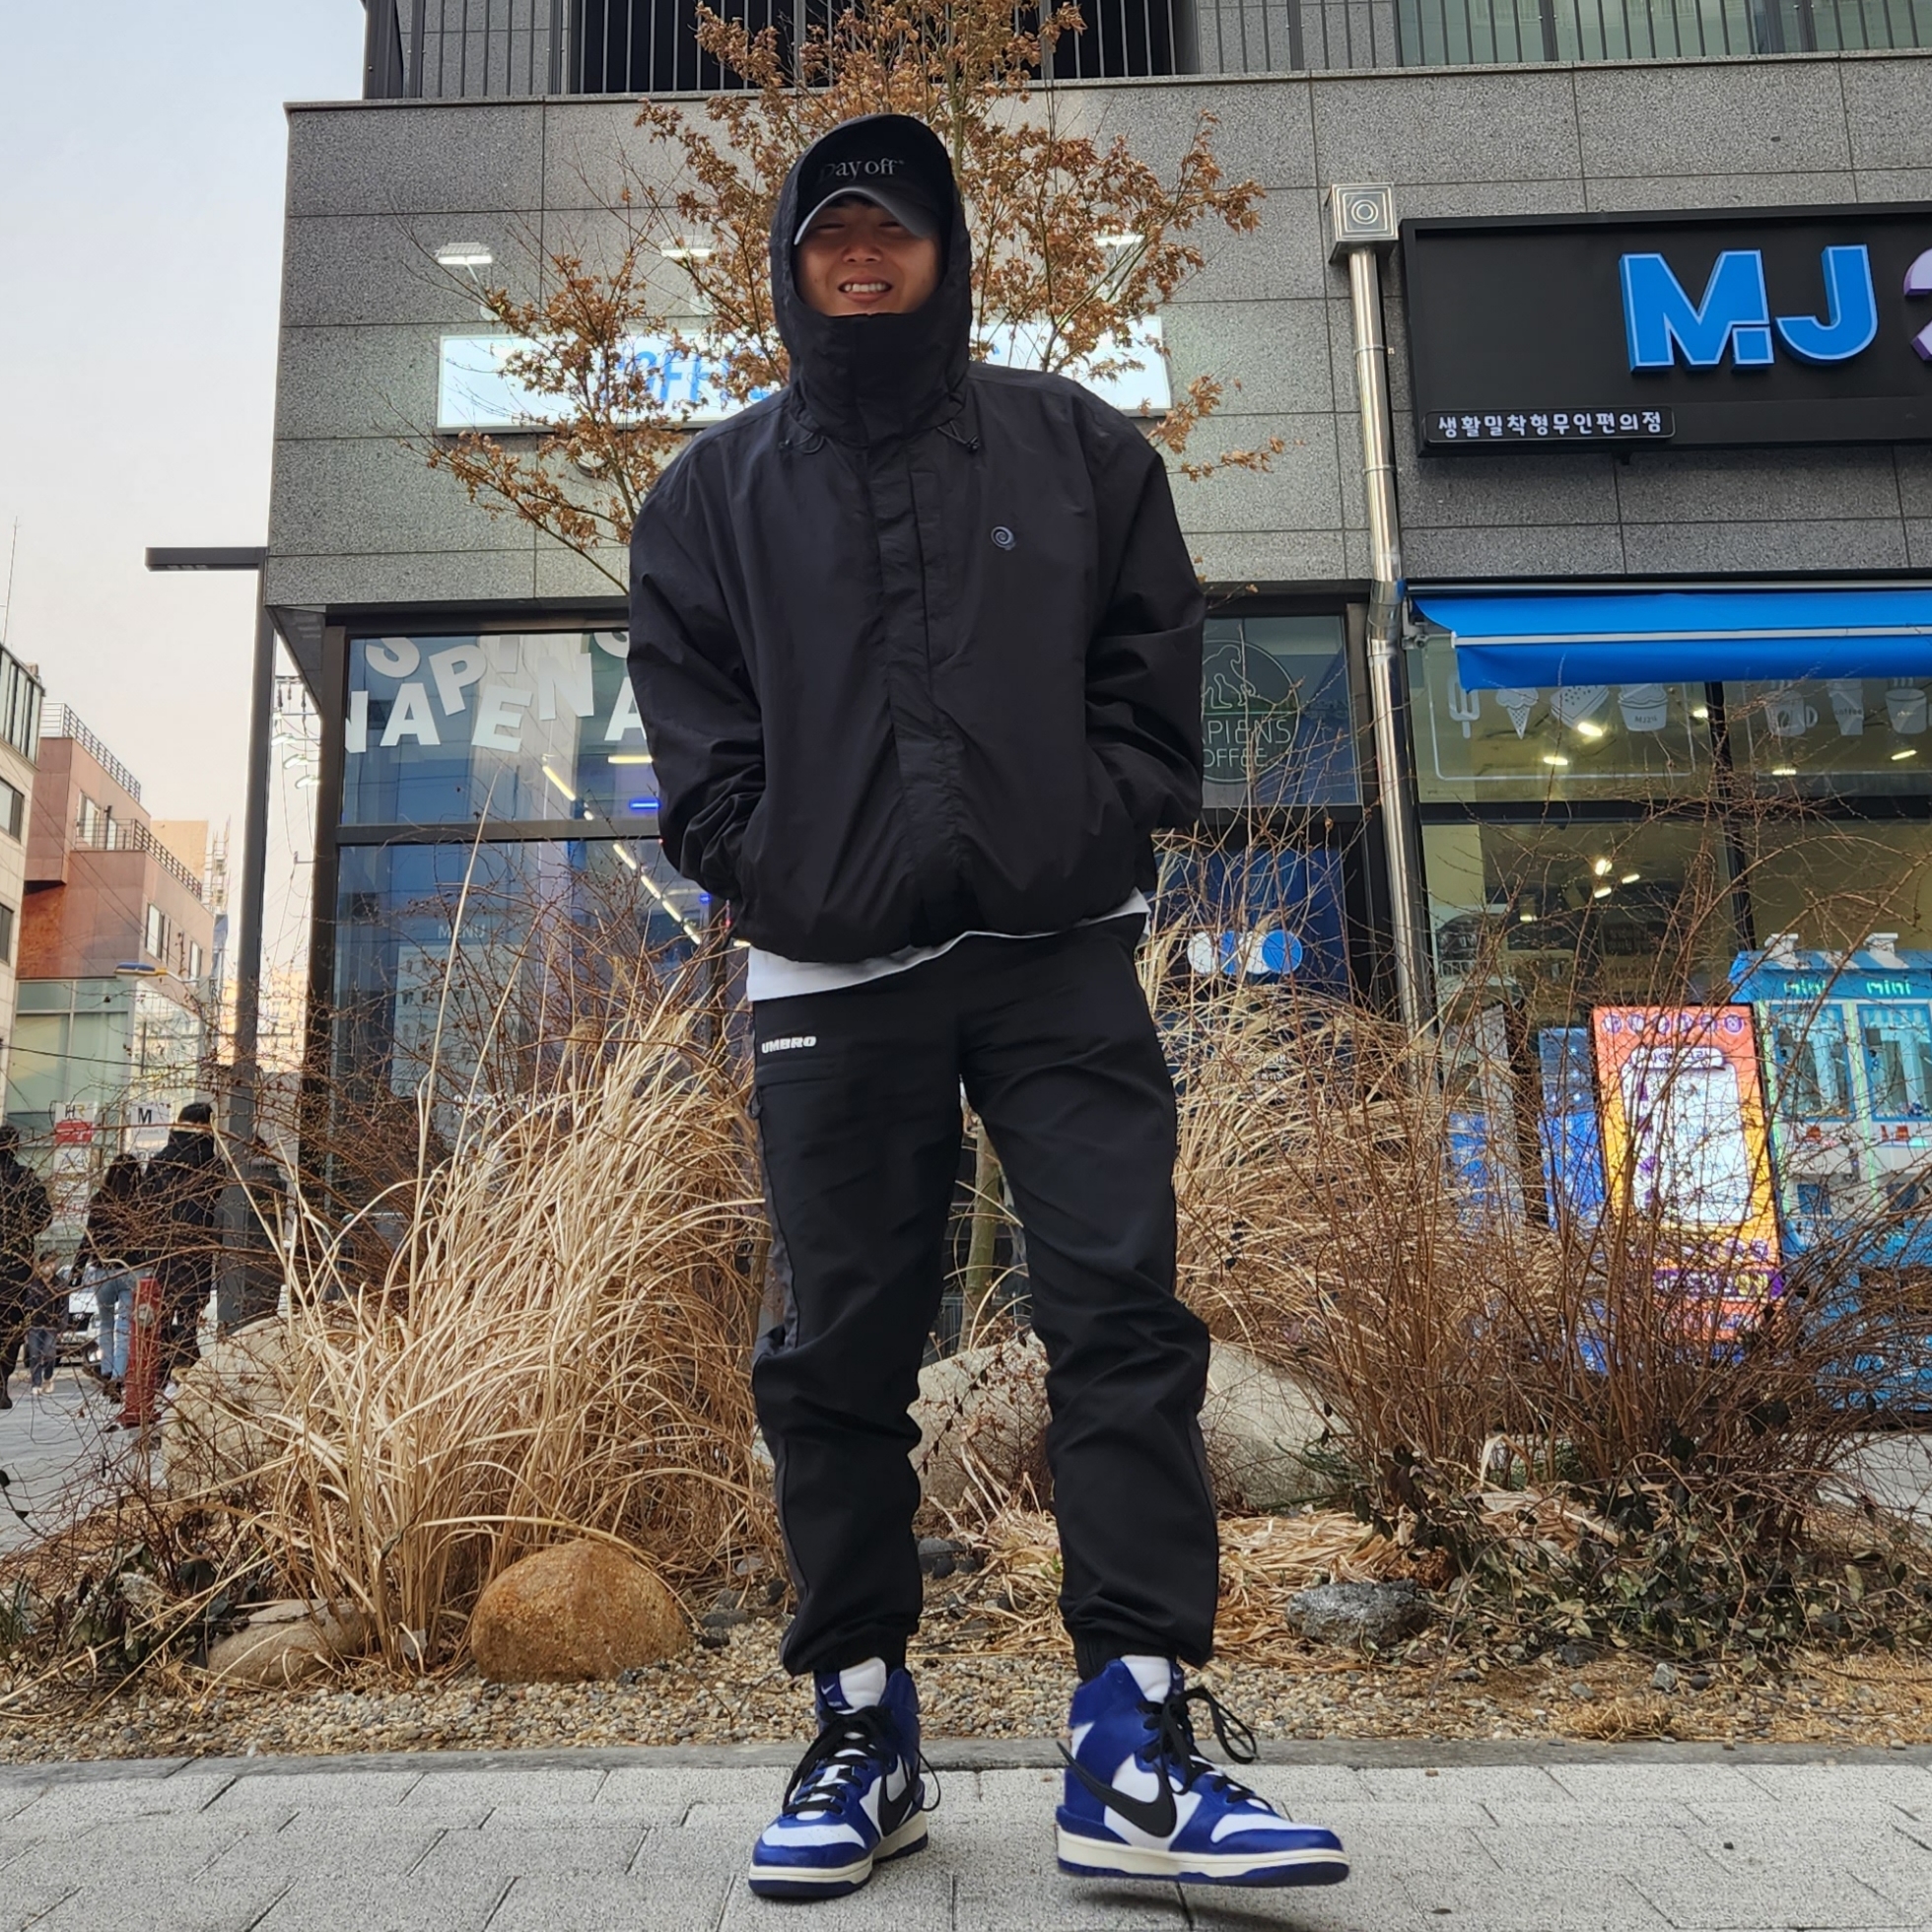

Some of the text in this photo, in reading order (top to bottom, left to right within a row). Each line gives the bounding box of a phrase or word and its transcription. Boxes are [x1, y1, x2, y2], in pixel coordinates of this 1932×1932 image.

[1438, 411, 1662, 439] 생활밀착형무인편의점
[1203, 719, 1291, 744] PIENS
[1866, 979, 1911, 996] mini
[761, 1035, 817, 1054] UMBRO
